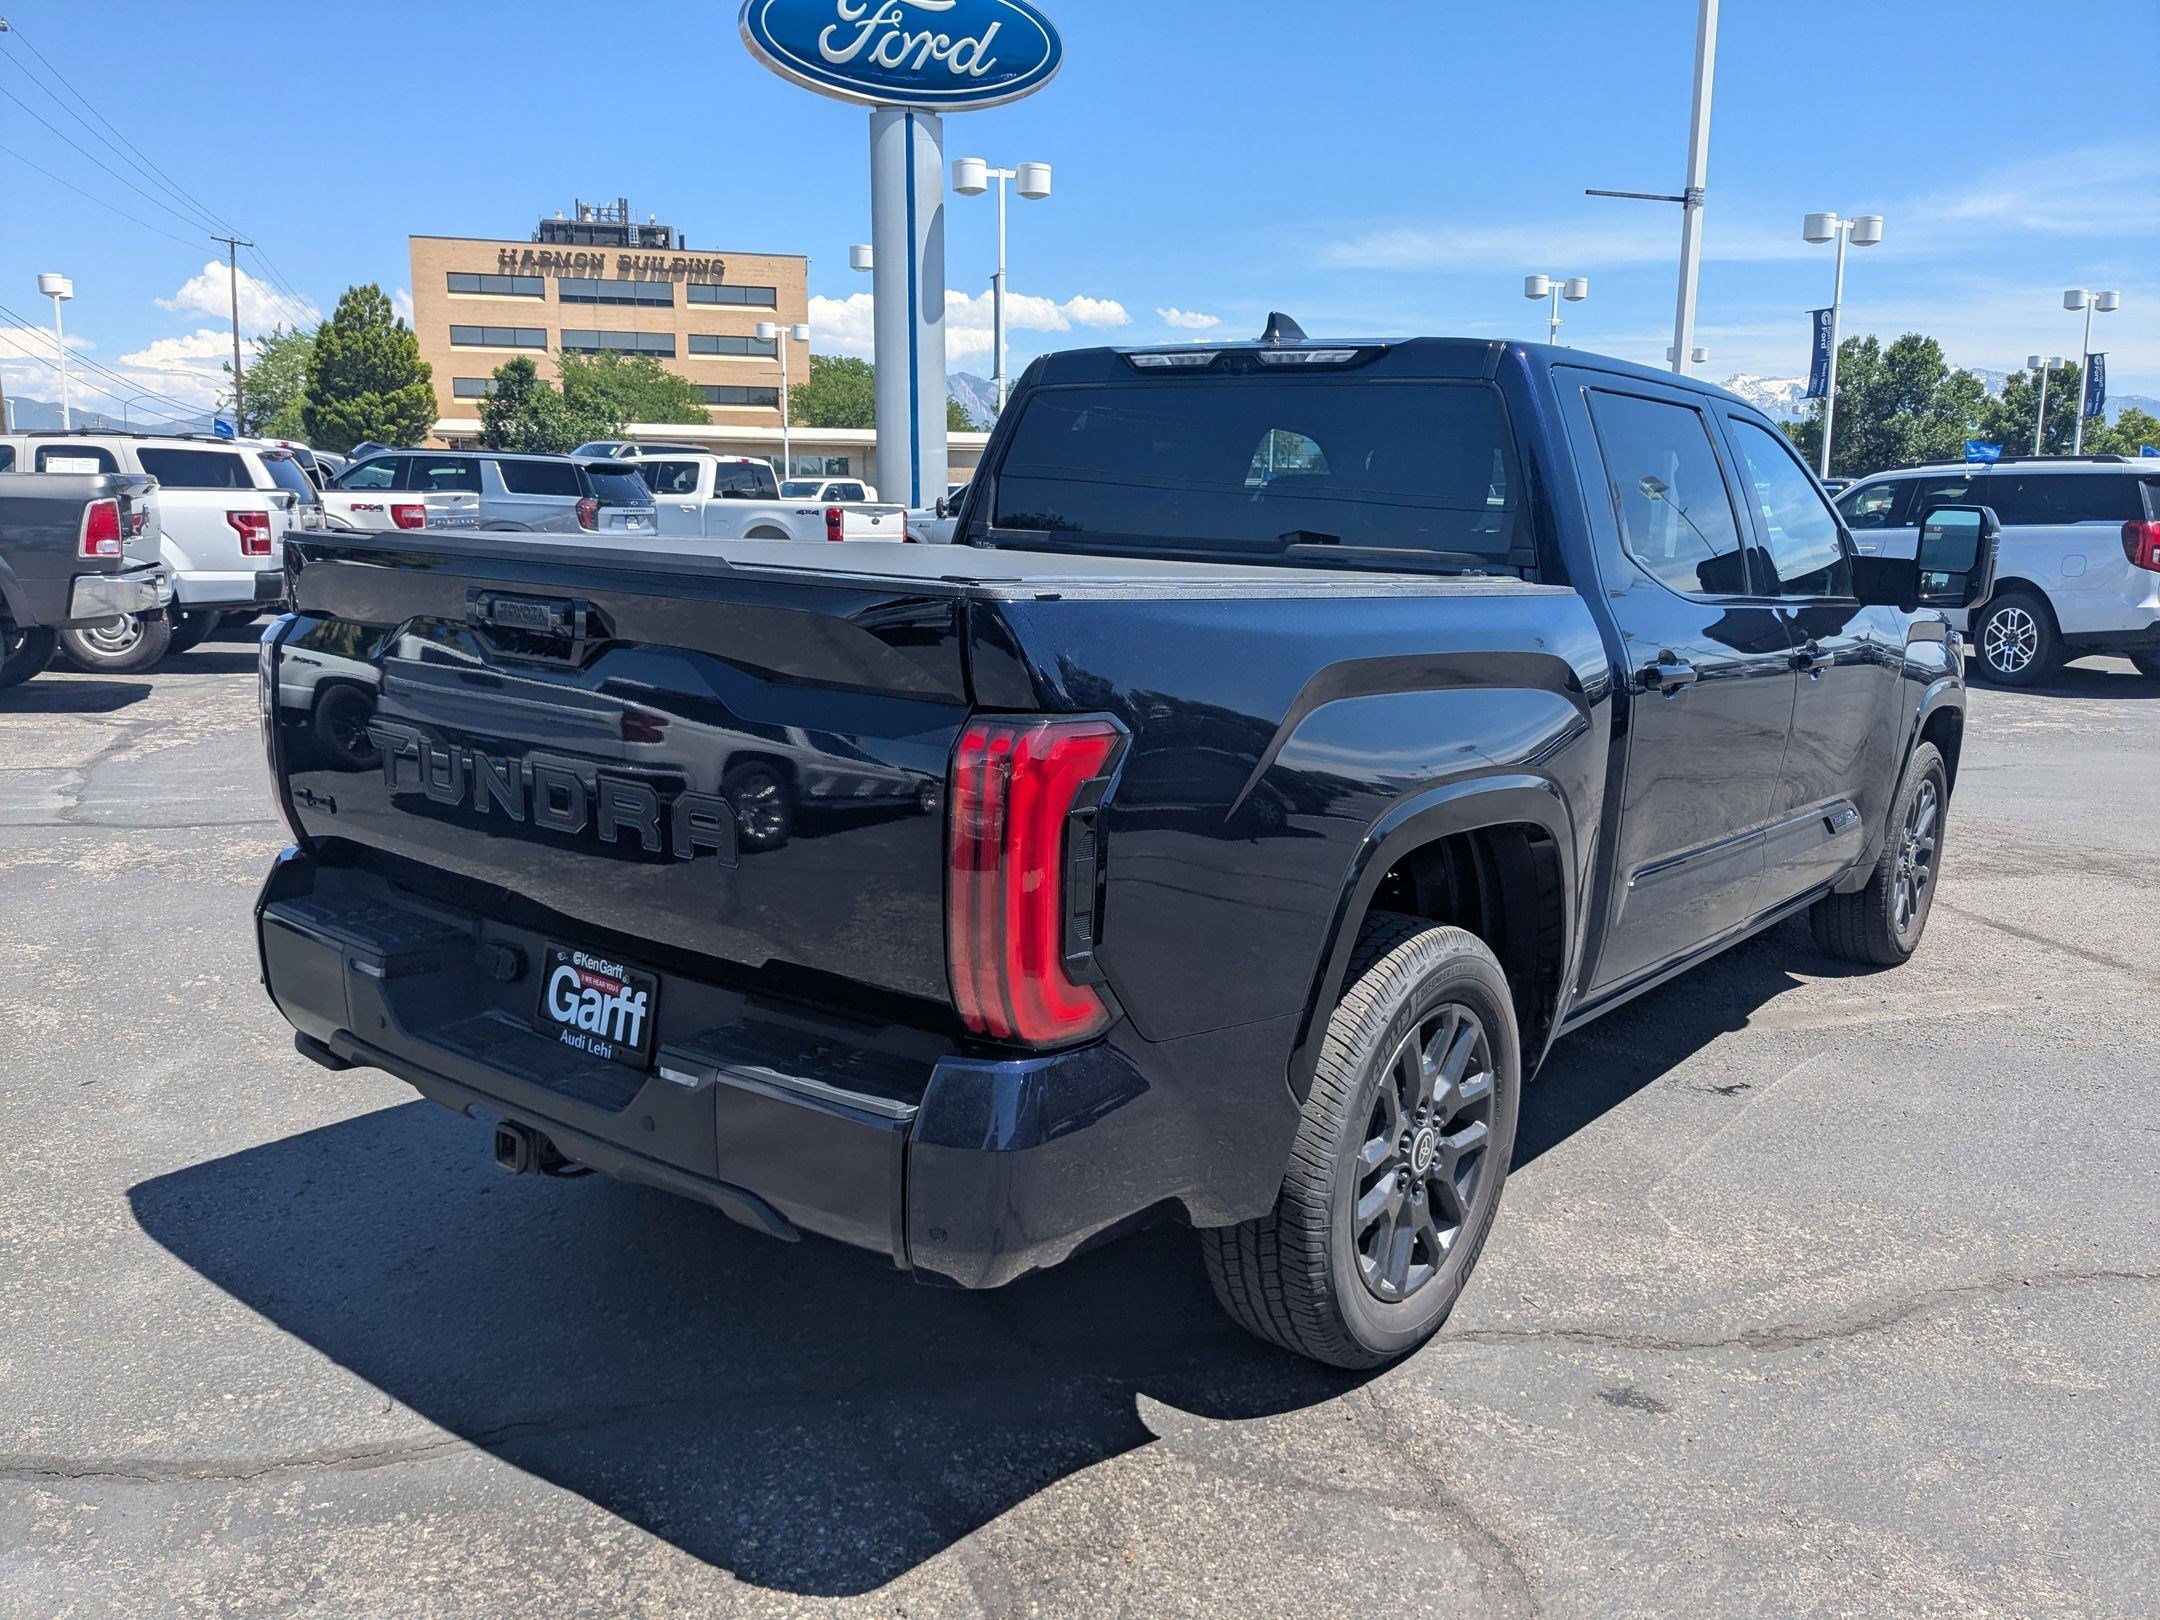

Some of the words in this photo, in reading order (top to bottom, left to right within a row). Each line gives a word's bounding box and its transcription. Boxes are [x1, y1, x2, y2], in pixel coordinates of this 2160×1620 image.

[818, 0, 1002, 77] Ford
[498, 248, 606, 271] HARMON
[617, 254, 726, 277] BUILDING
[350, 503, 384, 513] FX4
[366, 726, 739, 869] TUNDRA
[548, 965, 647, 1047] Garff
[560, 1029, 586, 1050] Audi
[588, 1038, 612, 1059] Lehi
